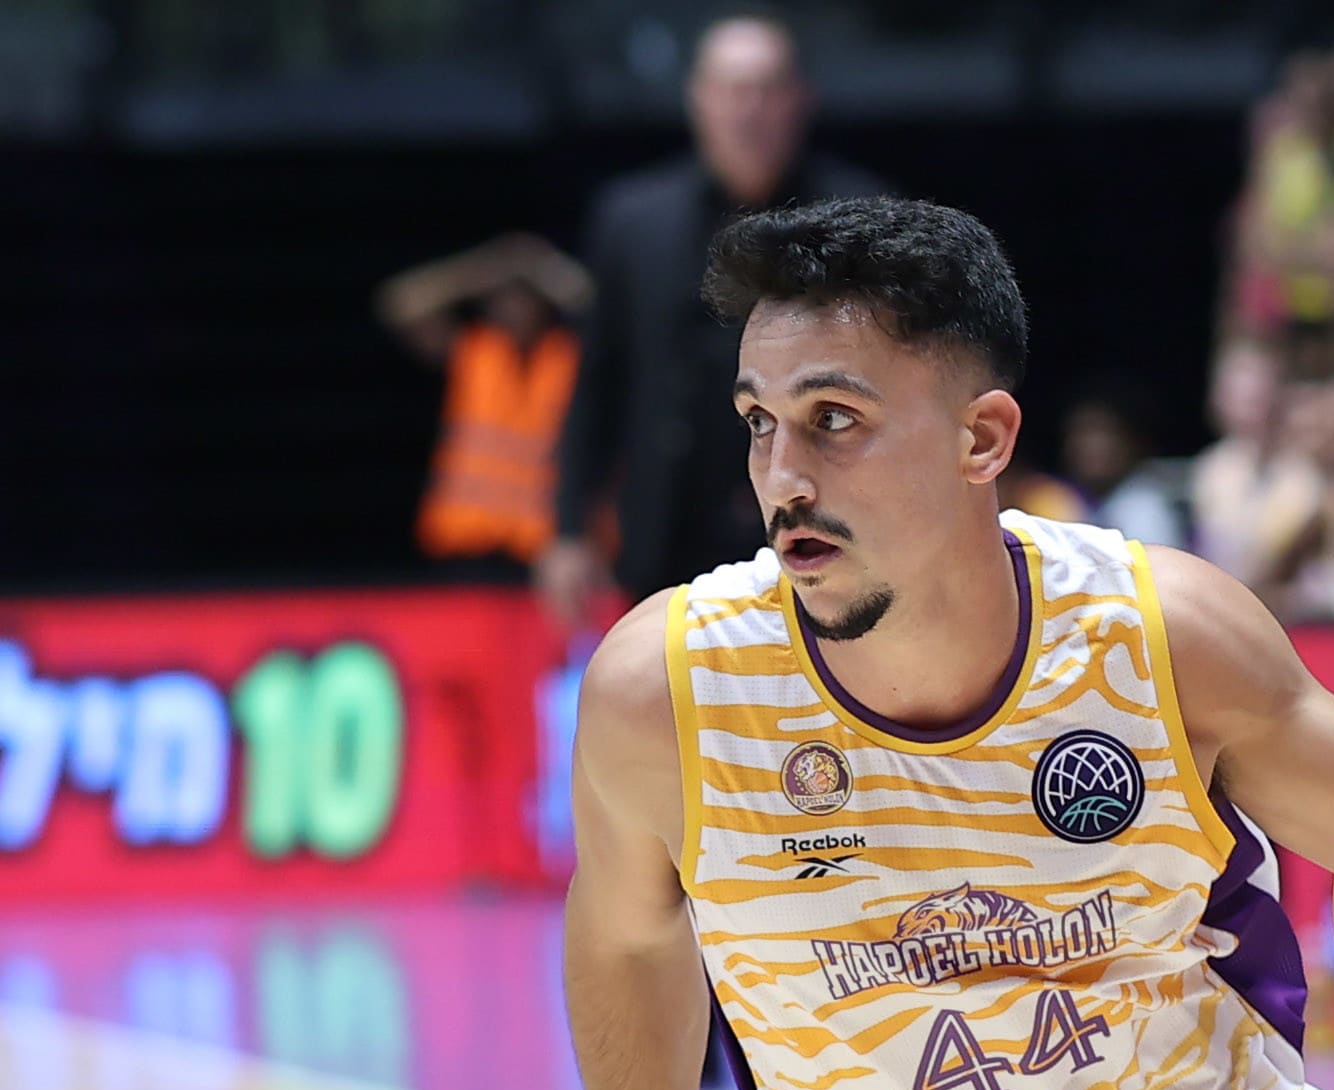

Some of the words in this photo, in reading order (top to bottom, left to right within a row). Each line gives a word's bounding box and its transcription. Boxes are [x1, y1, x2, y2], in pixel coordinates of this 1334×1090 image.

[0, 637, 231, 852] מיל
[231, 640, 403, 862] 10
[781, 833, 867, 855] Reebok
[811, 931, 981, 1000] HAPOEL
[986, 889, 1117, 968] HOLON
